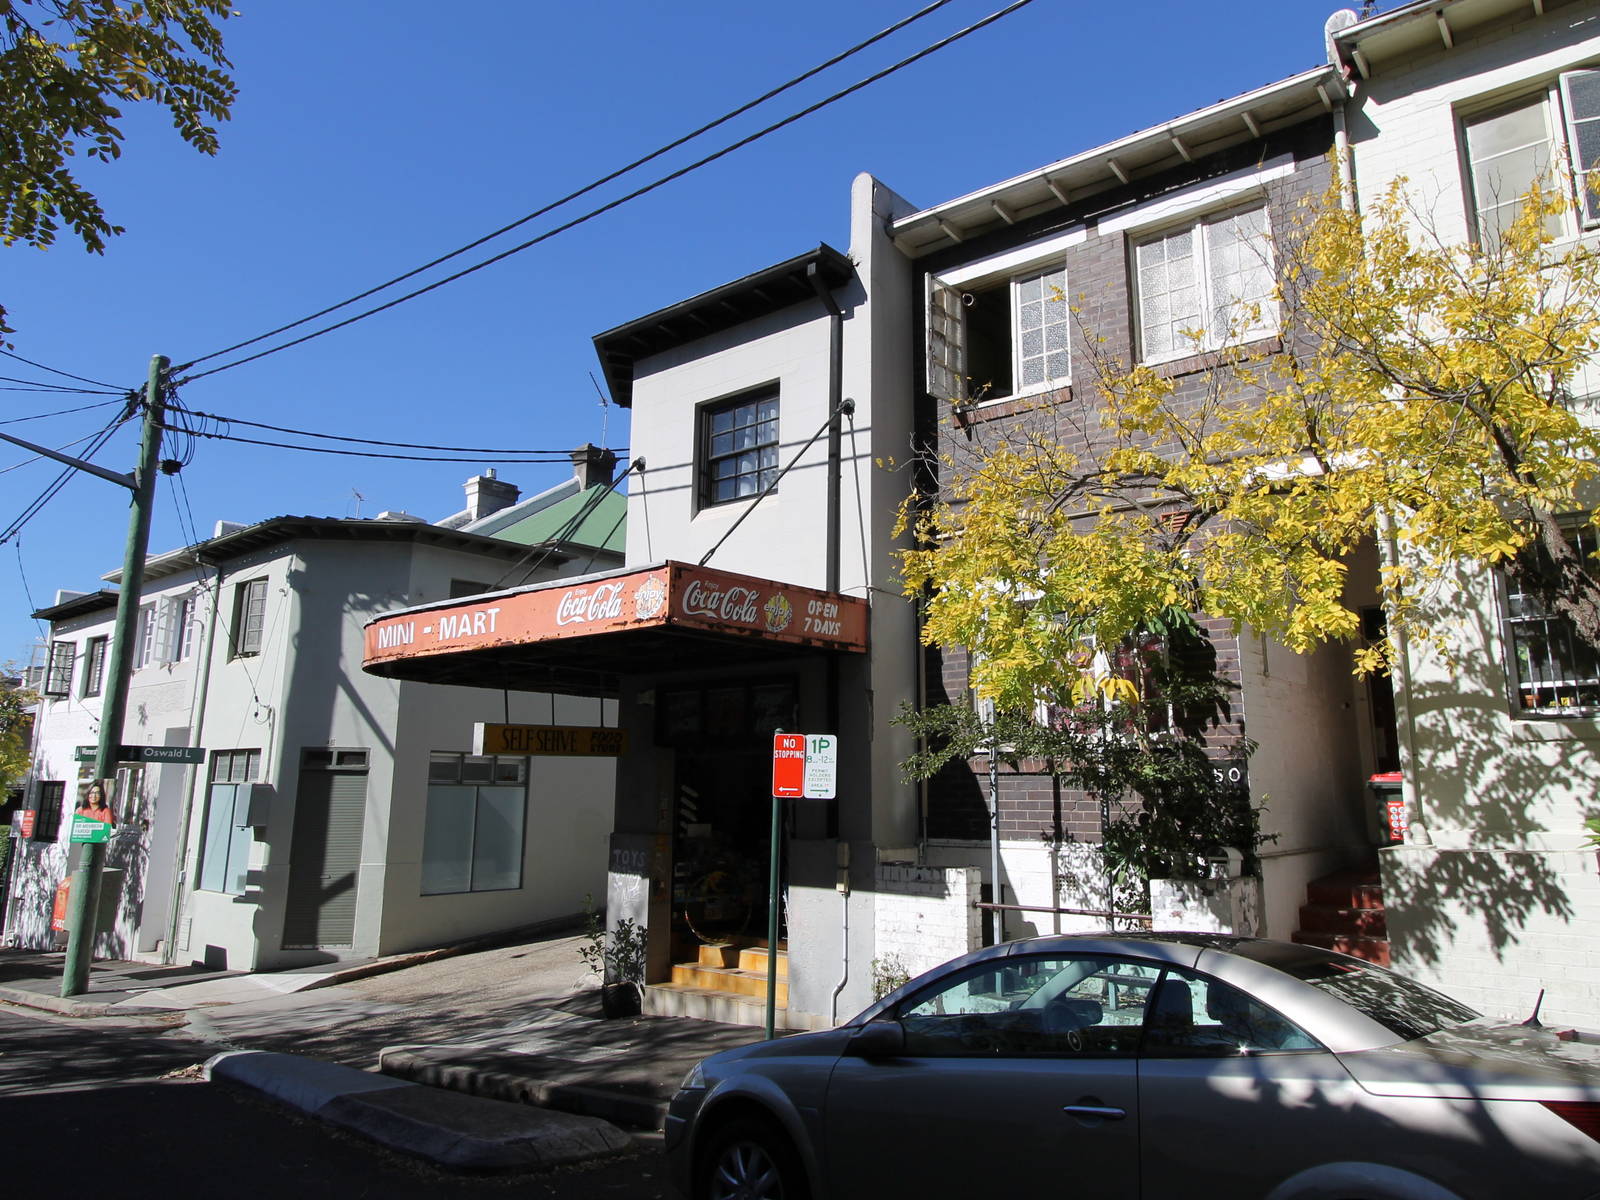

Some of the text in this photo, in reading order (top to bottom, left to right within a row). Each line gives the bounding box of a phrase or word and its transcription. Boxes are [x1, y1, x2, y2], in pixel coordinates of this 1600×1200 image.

[557, 582, 625, 626] Coca-Cola
[683, 580, 760, 623] Coca-Cola
[807, 599, 839, 618] OPEN
[378, 621, 415, 649] MINI
[439, 607, 501, 641] MART
[803, 617, 813, 632] 7
[813, 618, 841, 636] DAYS
[783, 738, 796, 748] NO
[812, 738, 830, 754] 1P
[144, 747, 182, 758] Oswald
[774, 750, 805, 759] STOPPING
[1213, 767, 1241, 783] 50
[613, 849, 646, 867] TOYS
